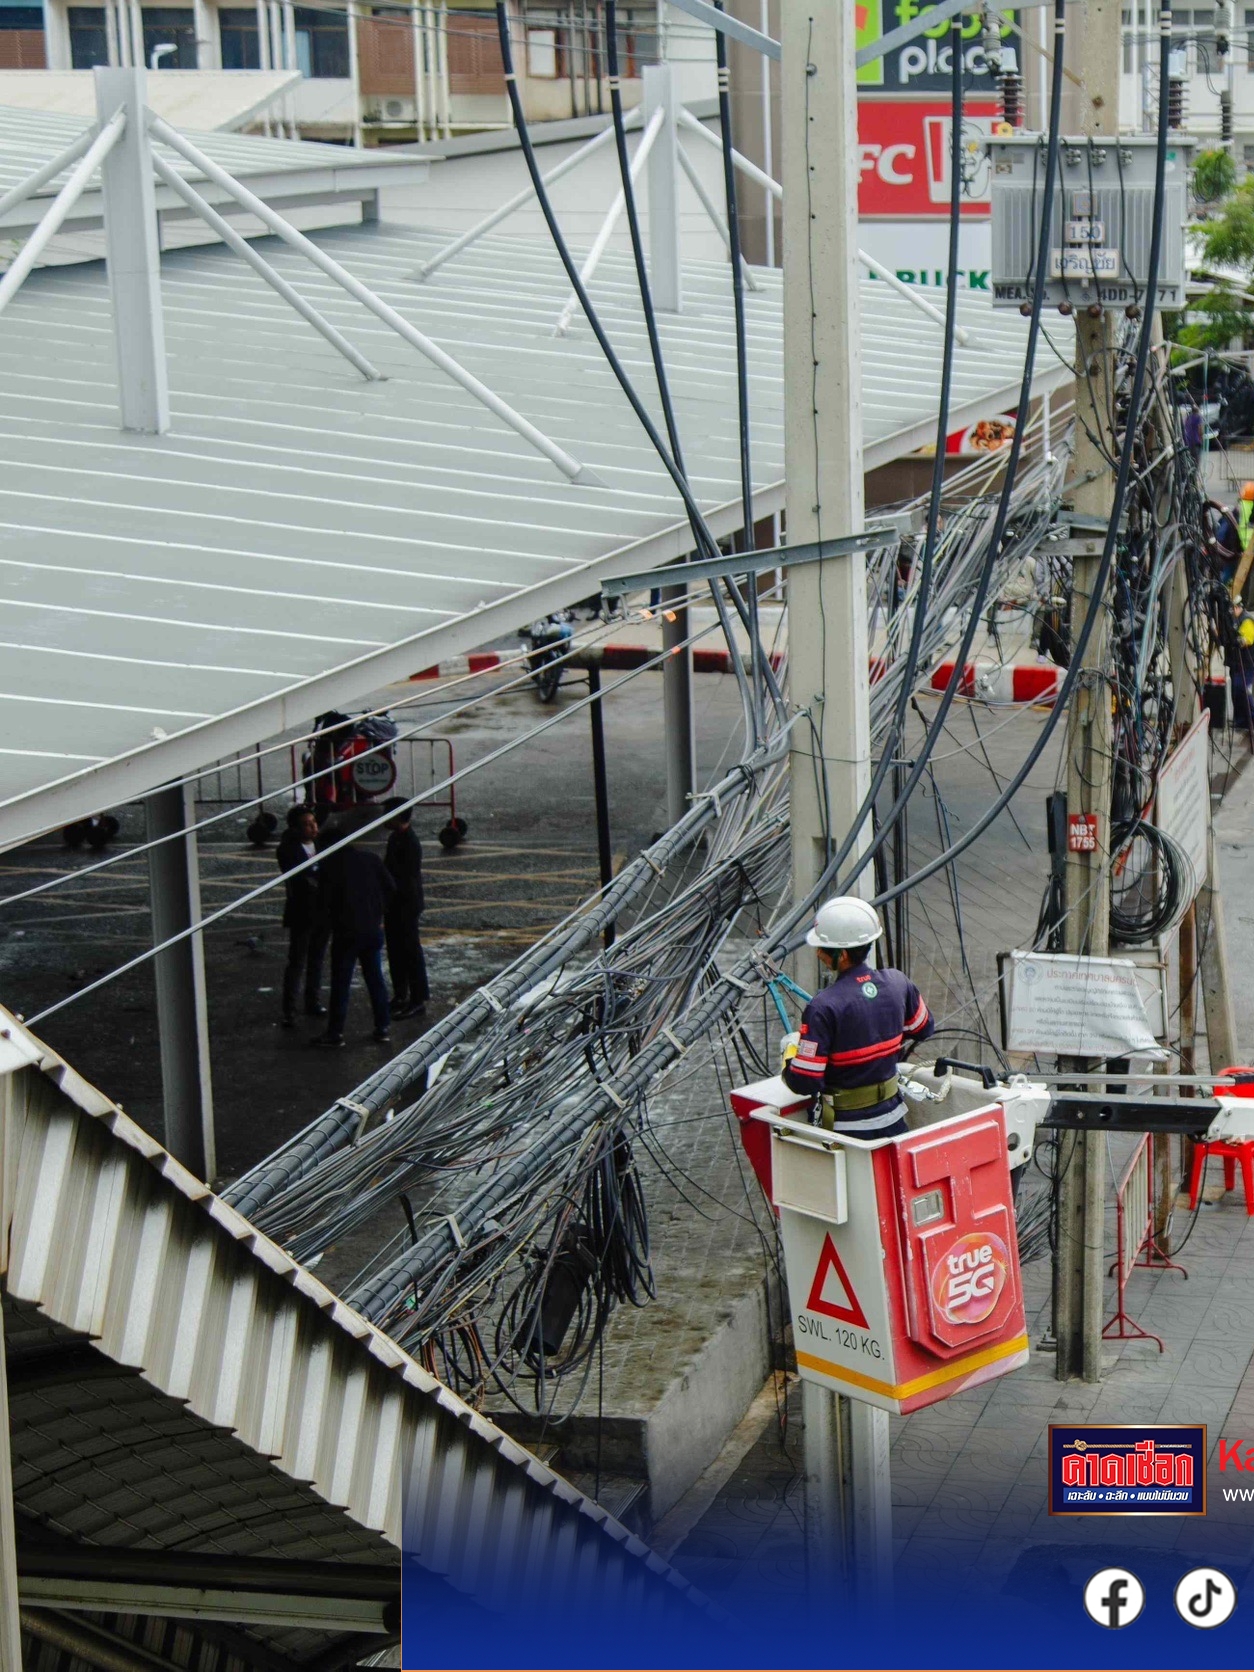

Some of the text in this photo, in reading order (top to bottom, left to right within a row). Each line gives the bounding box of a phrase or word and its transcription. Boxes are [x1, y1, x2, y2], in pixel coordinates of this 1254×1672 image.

[1070, 224, 1101, 239] 150
[356, 761, 389, 775] STOP
[947, 1243, 993, 1274] true
[947, 1263, 995, 1311] 5G
[797, 1314, 886, 1361] SWL. 120 KG.
